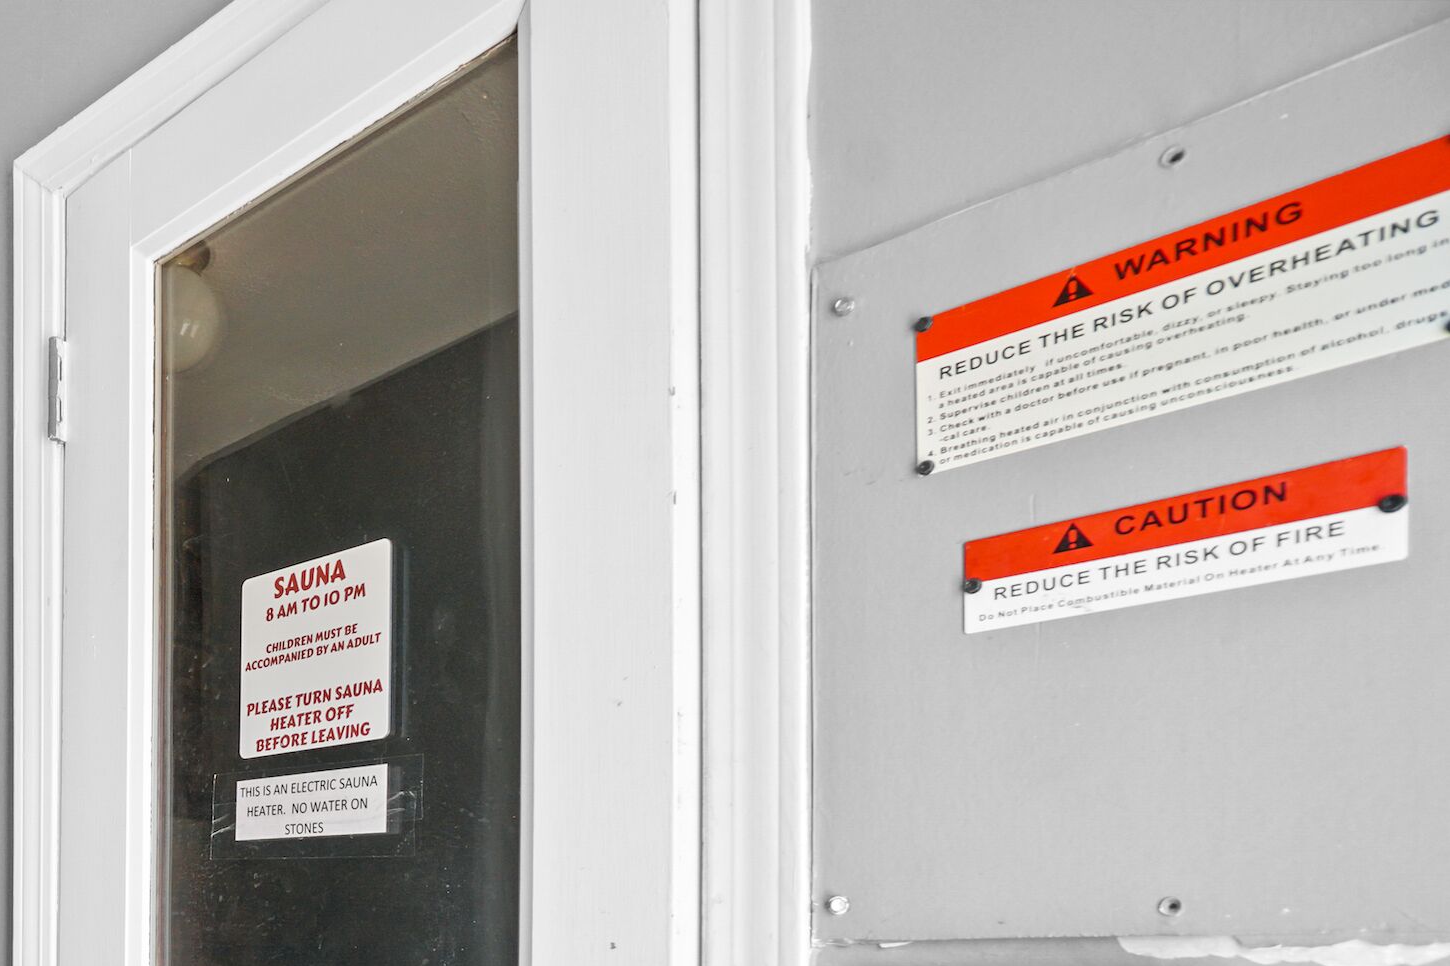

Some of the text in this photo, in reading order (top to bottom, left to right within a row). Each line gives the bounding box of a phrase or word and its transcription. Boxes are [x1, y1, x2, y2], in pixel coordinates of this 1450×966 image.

[1114, 201, 1305, 280] WARNING
[939, 210, 1440, 380] REDUCE THE RISK OF OVERHEATING
[939, 387, 960, 398] Exit
[965, 366, 1035, 390] immediately
[1057, 330, 1158, 363] uncomfortable,
[1162, 316, 1203, 331] dizzy,
[1208, 309, 1221, 317] or
[1227, 292, 1281, 312] sleepy.
[1286, 269, 1349, 294] Staying
[1354, 258, 1382, 273] too
[1387, 244, 1427, 263] long
[940, 419, 974, 432] Check
[978, 410, 1001, 421] with
[1014, 395, 1054, 411] doctor
[1058, 383, 1098, 399] before
[1102, 376, 1125, 387] use
[1130, 371, 1138, 379] if
[1142, 352, 1210, 377] pregnant,
[1215, 346, 1229, 354] in
[1233, 335, 1268, 351] poor
[1272, 318, 1328, 339] health,
[1334, 309, 1350, 321] or
[1356, 294, 1406, 314] under
[947, 390, 985, 406] heated
[989, 383, 1014, 394] area
[1030, 362, 1079, 381] capable
[1083, 357, 1095, 366] of
[1100, 341, 1152, 361] causing
[1156, 314, 1250, 344] overheating.
[940, 400, 996, 420] Supervise
[1000, 384, 1049, 403] children
[1054, 379, 1064, 387] at
[1068, 374, 1083, 383] all
[1086, 363, 1126, 378] times.
[941, 435, 996, 454] Breathing
[1000, 423, 1039, 438] heated
[1044, 418, 1059, 427] air
[1077, 391, 1157, 417] conjunction
[1162, 382, 1190, 394] with
[1195, 354, 1295, 385] consumption
[1301, 346, 1316, 356] of
[1321, 327, 1390, 350] alcohol,
[953, 439, 1018, 460] medication
[1035, 421, 1083, 440] capable
[1088, 416, 1099, 425] of
[1104, 403, 1156, 421] causing
[1161, 365, 1298, 405] unconsciousness.
[939, 426, 990, 442] -cal care.
[1115, 480, 1288, 536] CAUTION
[274, 559, 346, 598] SAUNA
[994, 521, 1345, 601] REDUCE THE RISK OF FIRE
[266, 608, 274, 621] 8
[278, 602, 297, 619] AM
[301, 595, 320, 612] TO
[344, 583, 365, 602] PM
[979, 613, 994, 622] Do
[999, 609, 1017, 619] Not
[1021, 603, 1053, 615] Place
[1058, 588, 1140, 608] Combustible
[1144, 575, 1200, 592] Material
[1205, 572, 1224, 582] On
[1229, 563, 1278, 577] Heater
[1283, 557, 1300, 568] At
[1304, 551, 1335, 564] Any
[245, 632, 381, 672] ACCOMPANIED BY AN ADULT
[266, 623, 358, 653] CHILDREN MUST BE
[247, 679, 383, 716] PLEASE TURN SAUNA
[271, 704, 354, 731] HEATER OFF
[256, 722, 370, 752] BEFORE LEAVING
[240, 775, 377, 798] THIS IS AN ELECTRIC SAUNA
[247, 798, 368, 817] HEATER. NO WATER ON
[285, 822, 324, 835] STONES
